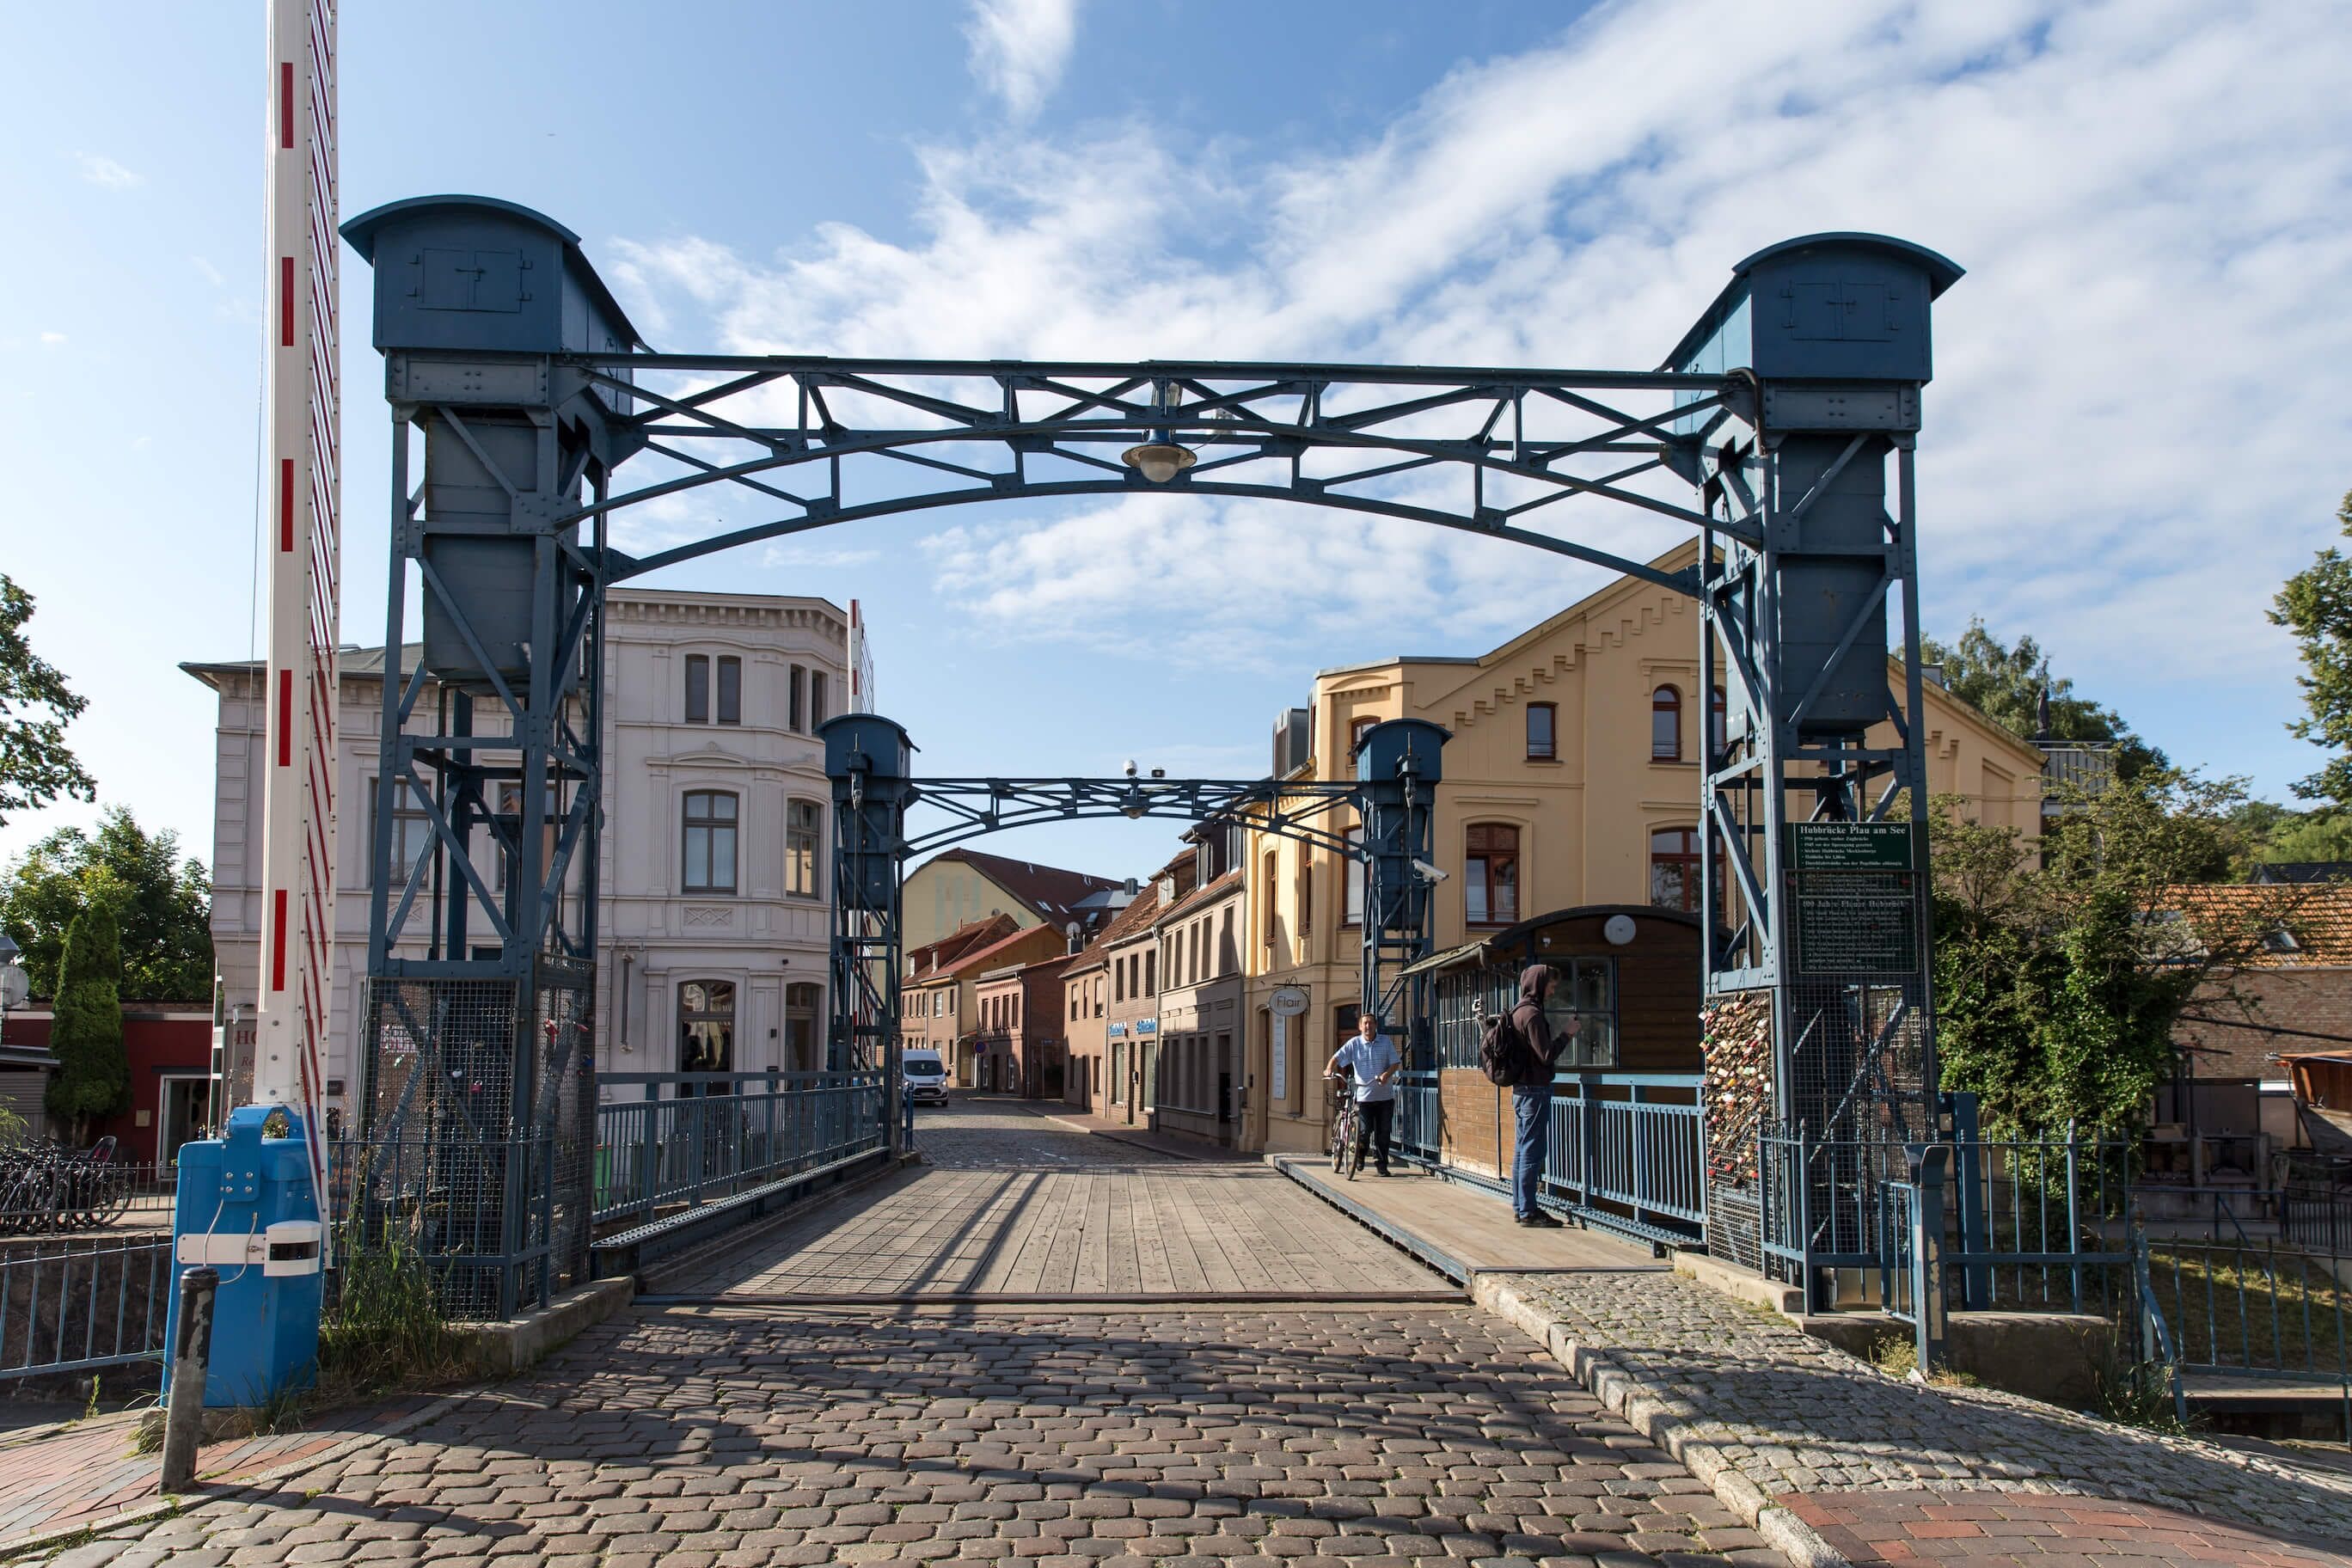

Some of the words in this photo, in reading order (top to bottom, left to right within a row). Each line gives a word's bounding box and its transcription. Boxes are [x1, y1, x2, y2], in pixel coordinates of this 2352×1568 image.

[1800, 825, 1847, 834] Hubbrücke
[1849, 825, 1870, 834] Plau
[1890, 825, 1906, 834] See
[1277, 995, 1302, 1008] Flair
